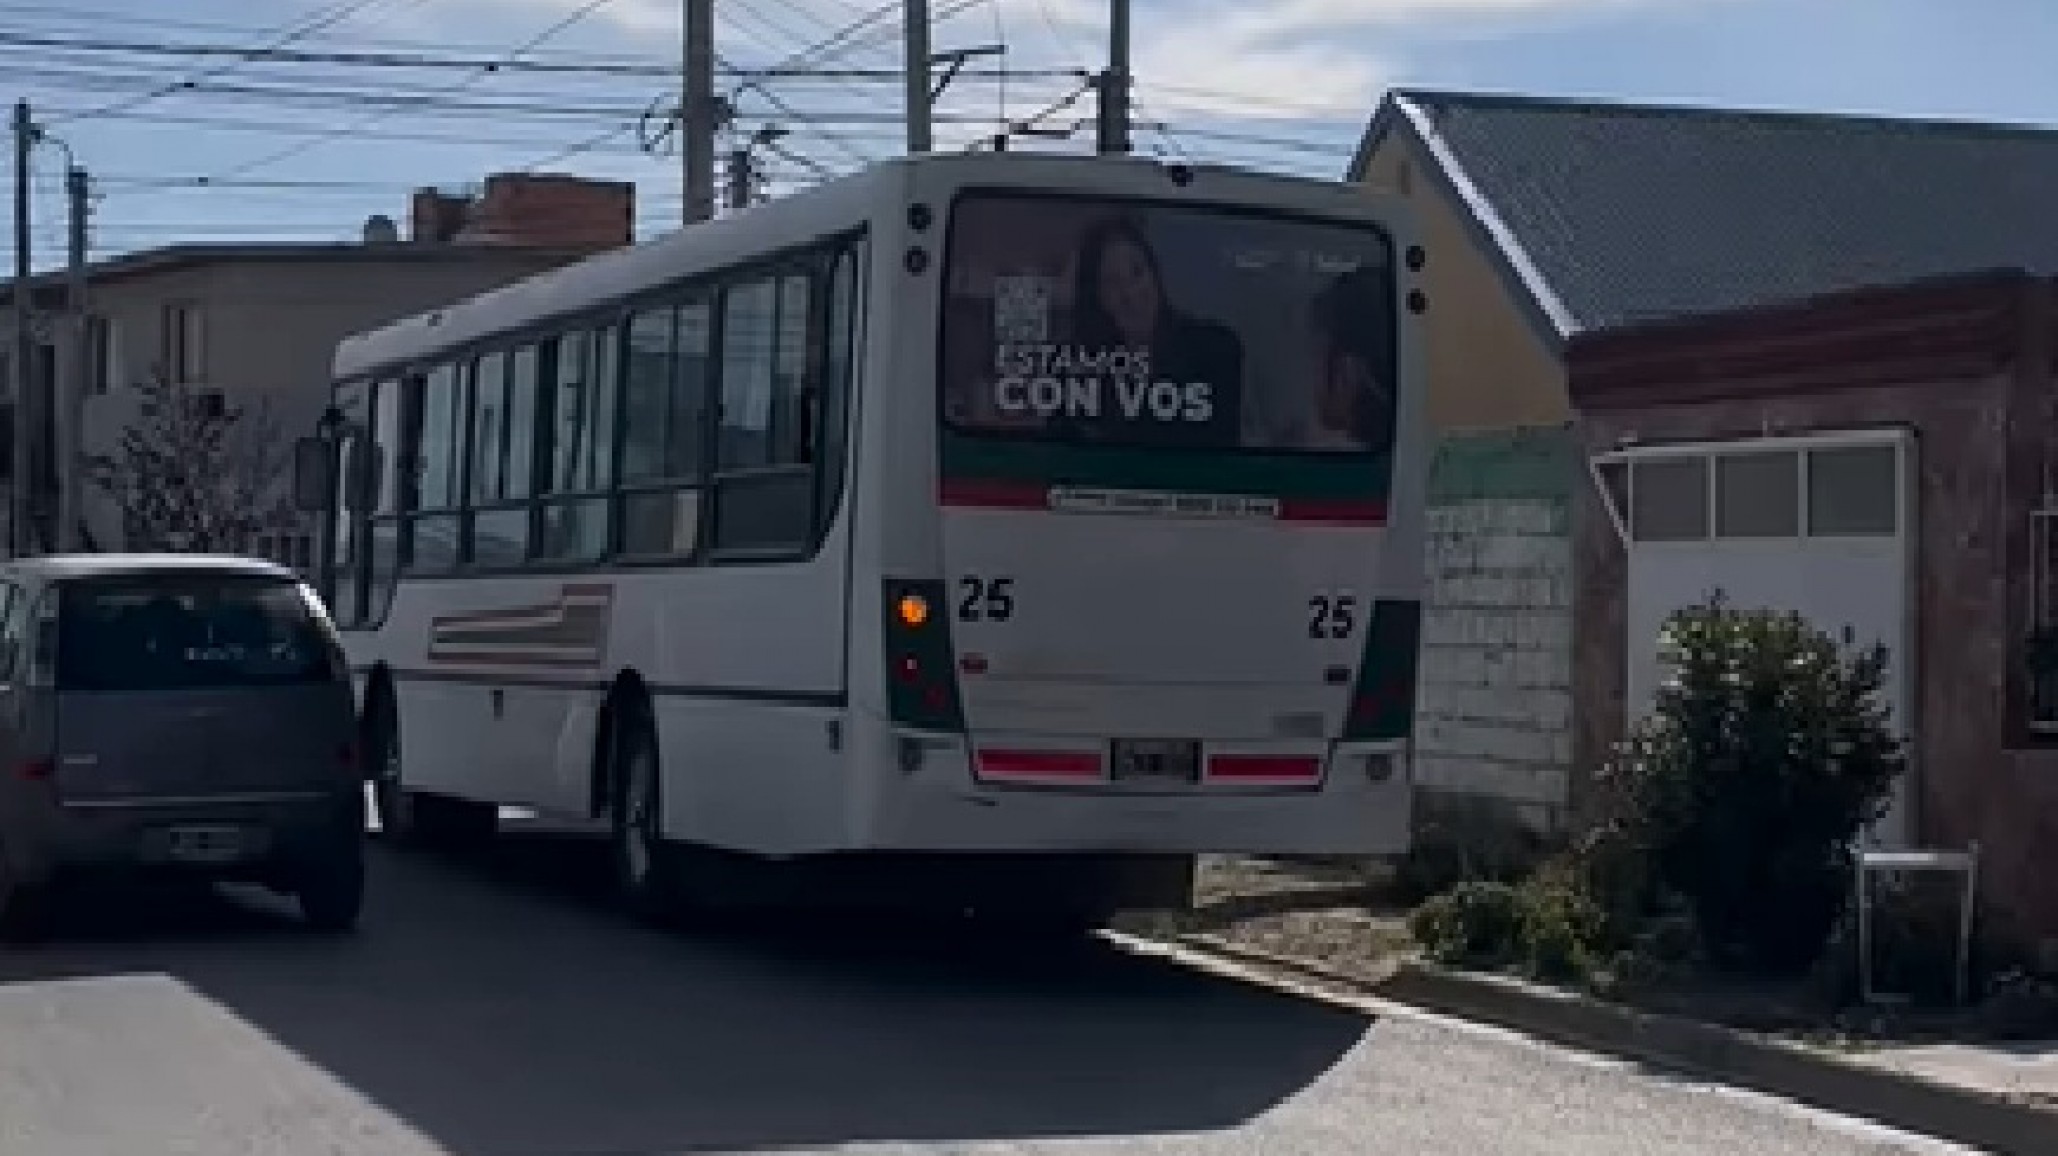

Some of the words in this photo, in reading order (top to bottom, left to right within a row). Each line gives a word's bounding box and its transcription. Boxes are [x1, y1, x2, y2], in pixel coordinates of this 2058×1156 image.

[995, 344, 1150, 374] ESTAMOS
[995, 378, 1100, 417] CON
[1117, 380, 1212, 421] VOS
[959, 575, 1014, 622] 25
[1309, 596, 1355, 639] 25
